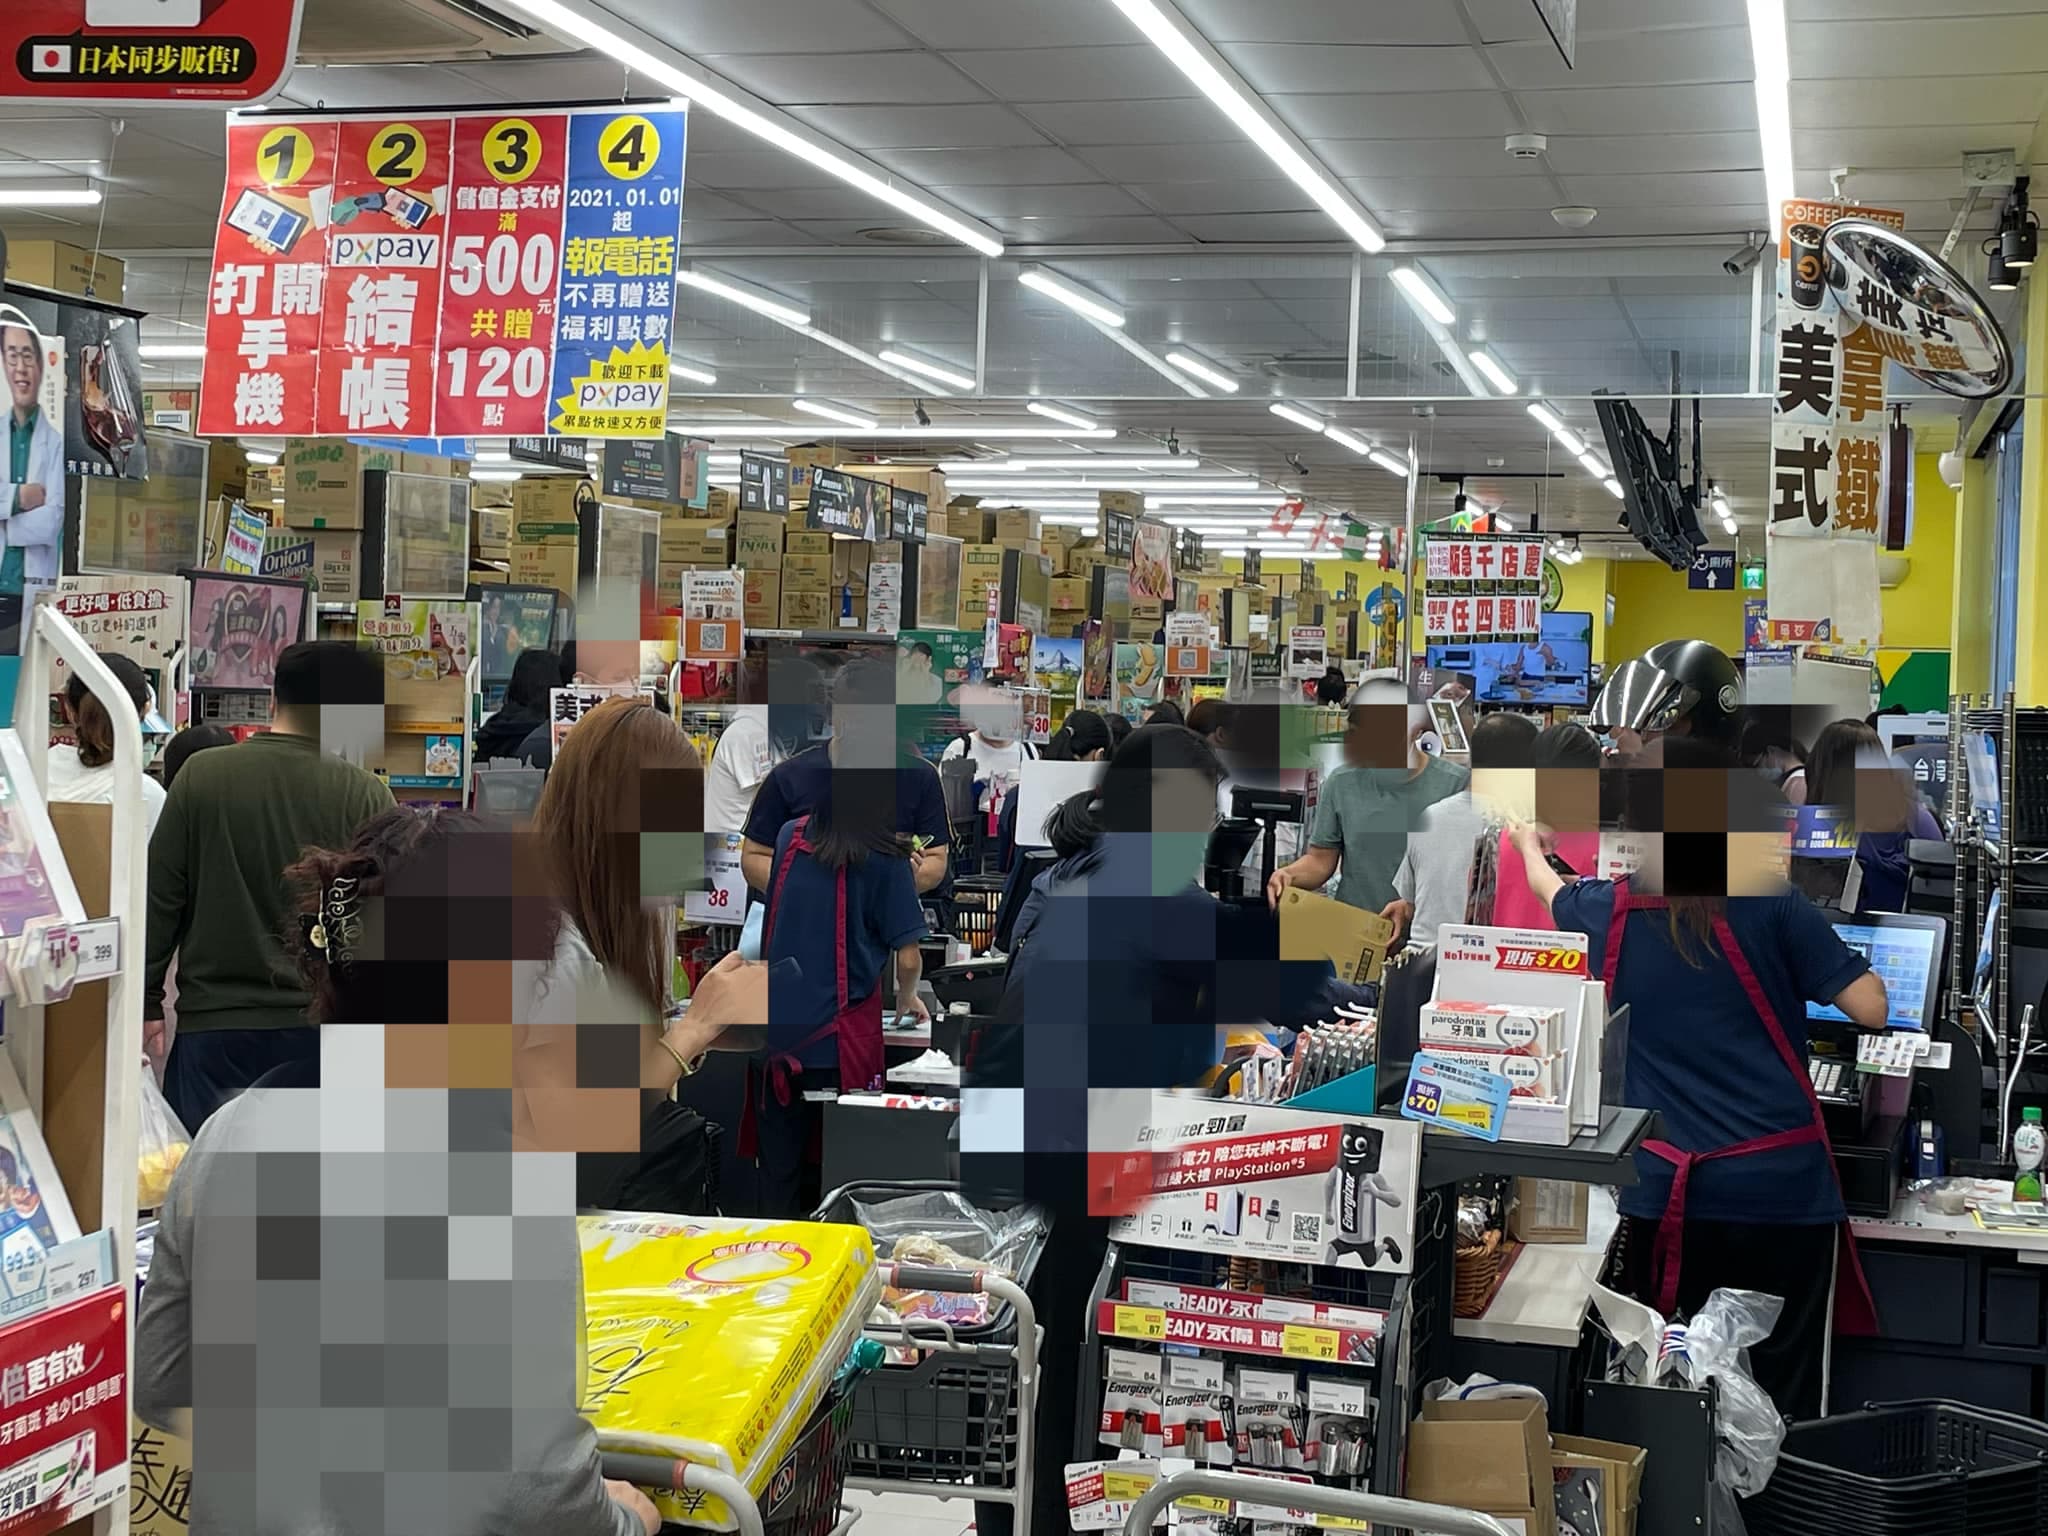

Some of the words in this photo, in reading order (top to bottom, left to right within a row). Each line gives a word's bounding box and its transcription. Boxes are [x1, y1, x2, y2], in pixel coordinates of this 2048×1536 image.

[78, 44, 241, 75] 日本同步販售!
[263, 135, 297, 180] 1
[376, 132, 417, 179] 2
[493, 127, 529, 175] 3
[607, 124, 646, 172] 4
[456, 185, 561, 210] 儲值金支付
[569, 187, 680, 208] 2021.01.01
[498, 212, 518, 232] 滿
[612, 211, 633, 232] 起
[1783, 202, 1840, 222] COFFEE
[450, 234, 555, 296] 500
[565, 236, 675, 278] 報電話
[213, 263, 324, 316] 打開
[564, 281, 670, 309] 不再贈送
[537, 298, 552, 315] 元
[470, 308, 534, 340] 共贈
[561, 314, 669, 342] 福利點數
[447, 346, 544, 398] 120
[602, 364, 664, 379] 歡迎下載
[482, 403, 504, 426] 點
[563, 415, 662, 430] 累點快速又方便
[1772, 321, 1837, 528] 美式
[264, 547, 307, 572] Onion
[1034, 718, 1049, 734] 30
[708, 889, 729, 907] 38
[1431, 1014, 1486, 1026] parodontax
[1408, 1095, 1437, 1113] $70
[1213, 1133, 1330, 1164] 陪您玩樂不斷電!
[1341, 1171, 1357, 1232] Energizer
[1321, 1346, 1333, 1357] 87
[1144, 1371, 1156, 1381] 84
[1206, 1378, 1218, 1388] 84
[1107, 1381, 1154, 1397] Energizer
[1277, 1391, 1289, 1400] 87
[1165, 1392, 1212, 1407] Energizer
[1341, 1402, 1359, 1413] 127
[1102, 1413, 1112, 1425] 5
[1236, 1403, 1279, 1417] Energizer
[1163, 1427, 1172, 1439] 5
[1212, 1499, 1224, 1509] 77
